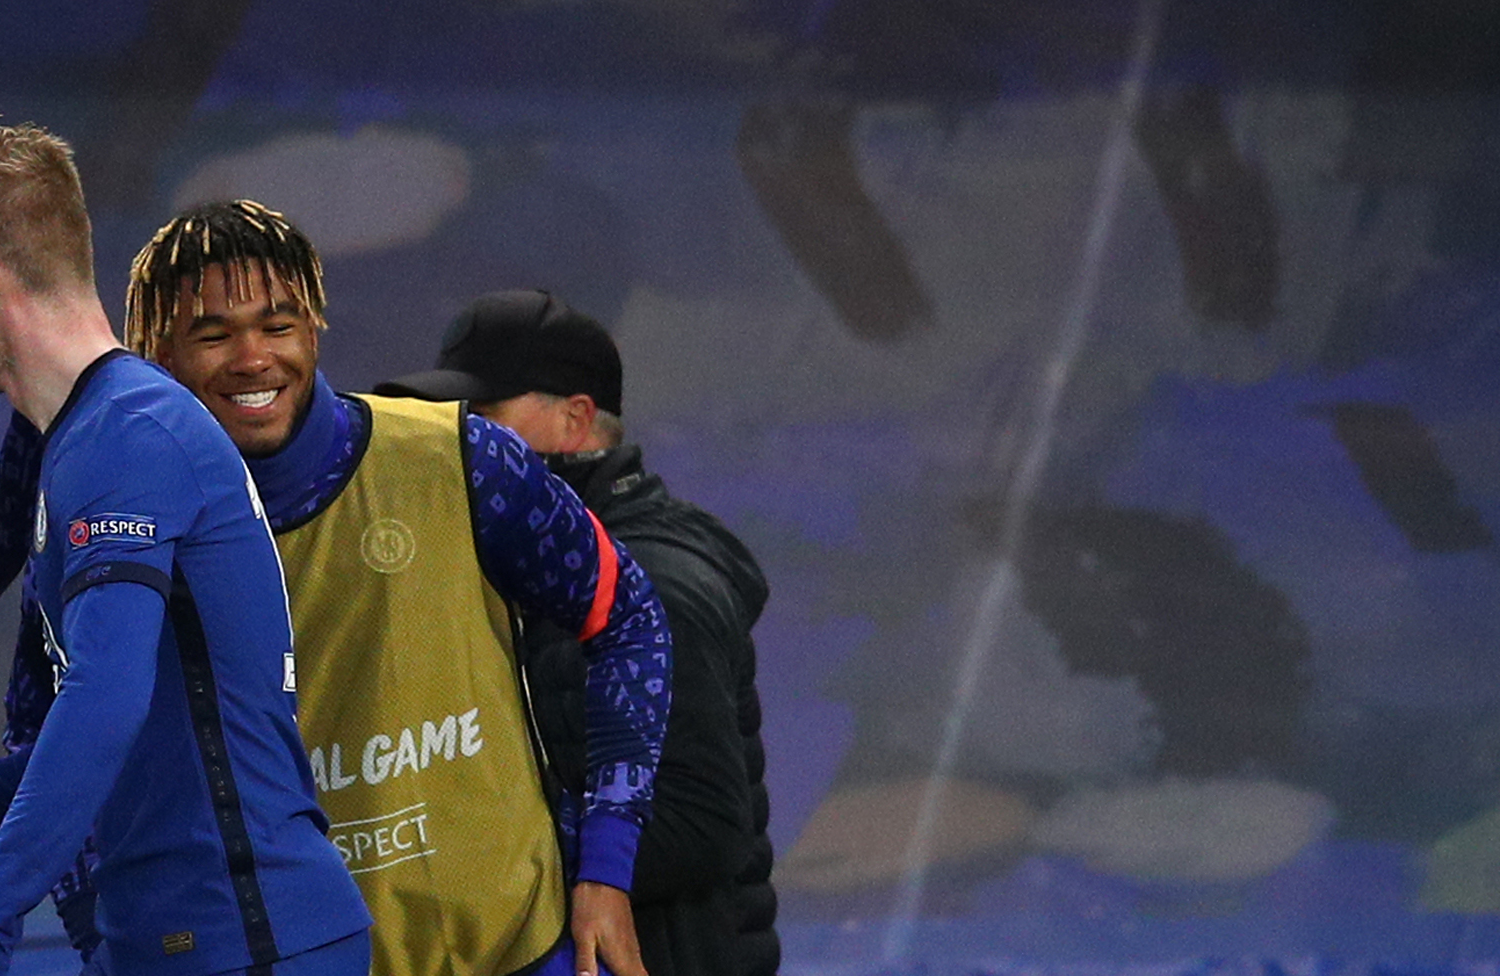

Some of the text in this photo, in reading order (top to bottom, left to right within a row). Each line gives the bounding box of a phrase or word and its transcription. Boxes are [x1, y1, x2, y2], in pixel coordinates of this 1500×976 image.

[90, 520, 156, 537] RESPECT
[310, 707, 483, 792] AL GAME
[332, 814, 427, 863] SPECT
